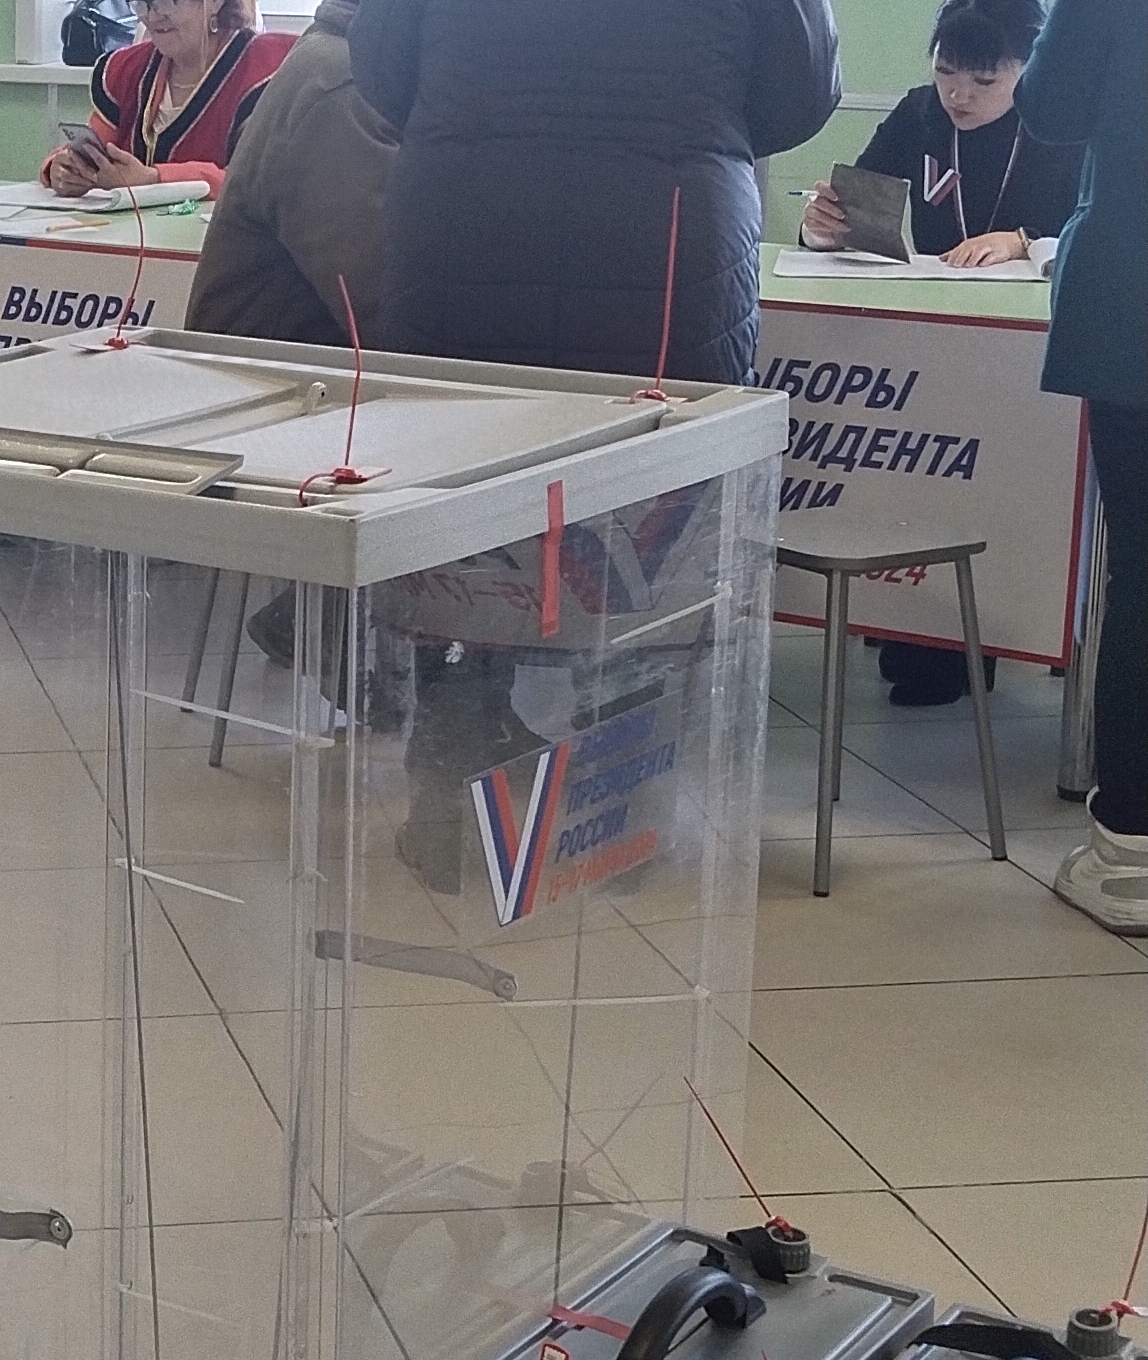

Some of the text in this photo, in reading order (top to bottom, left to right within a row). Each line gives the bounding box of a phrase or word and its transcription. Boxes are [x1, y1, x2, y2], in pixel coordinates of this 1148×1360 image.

[1, 286, 155, 329] ВЫБОРЫ
[753, 358, 919, 411] ЫБОРЫ
[782, 418, 980, 480] ЗИДЕНТА
